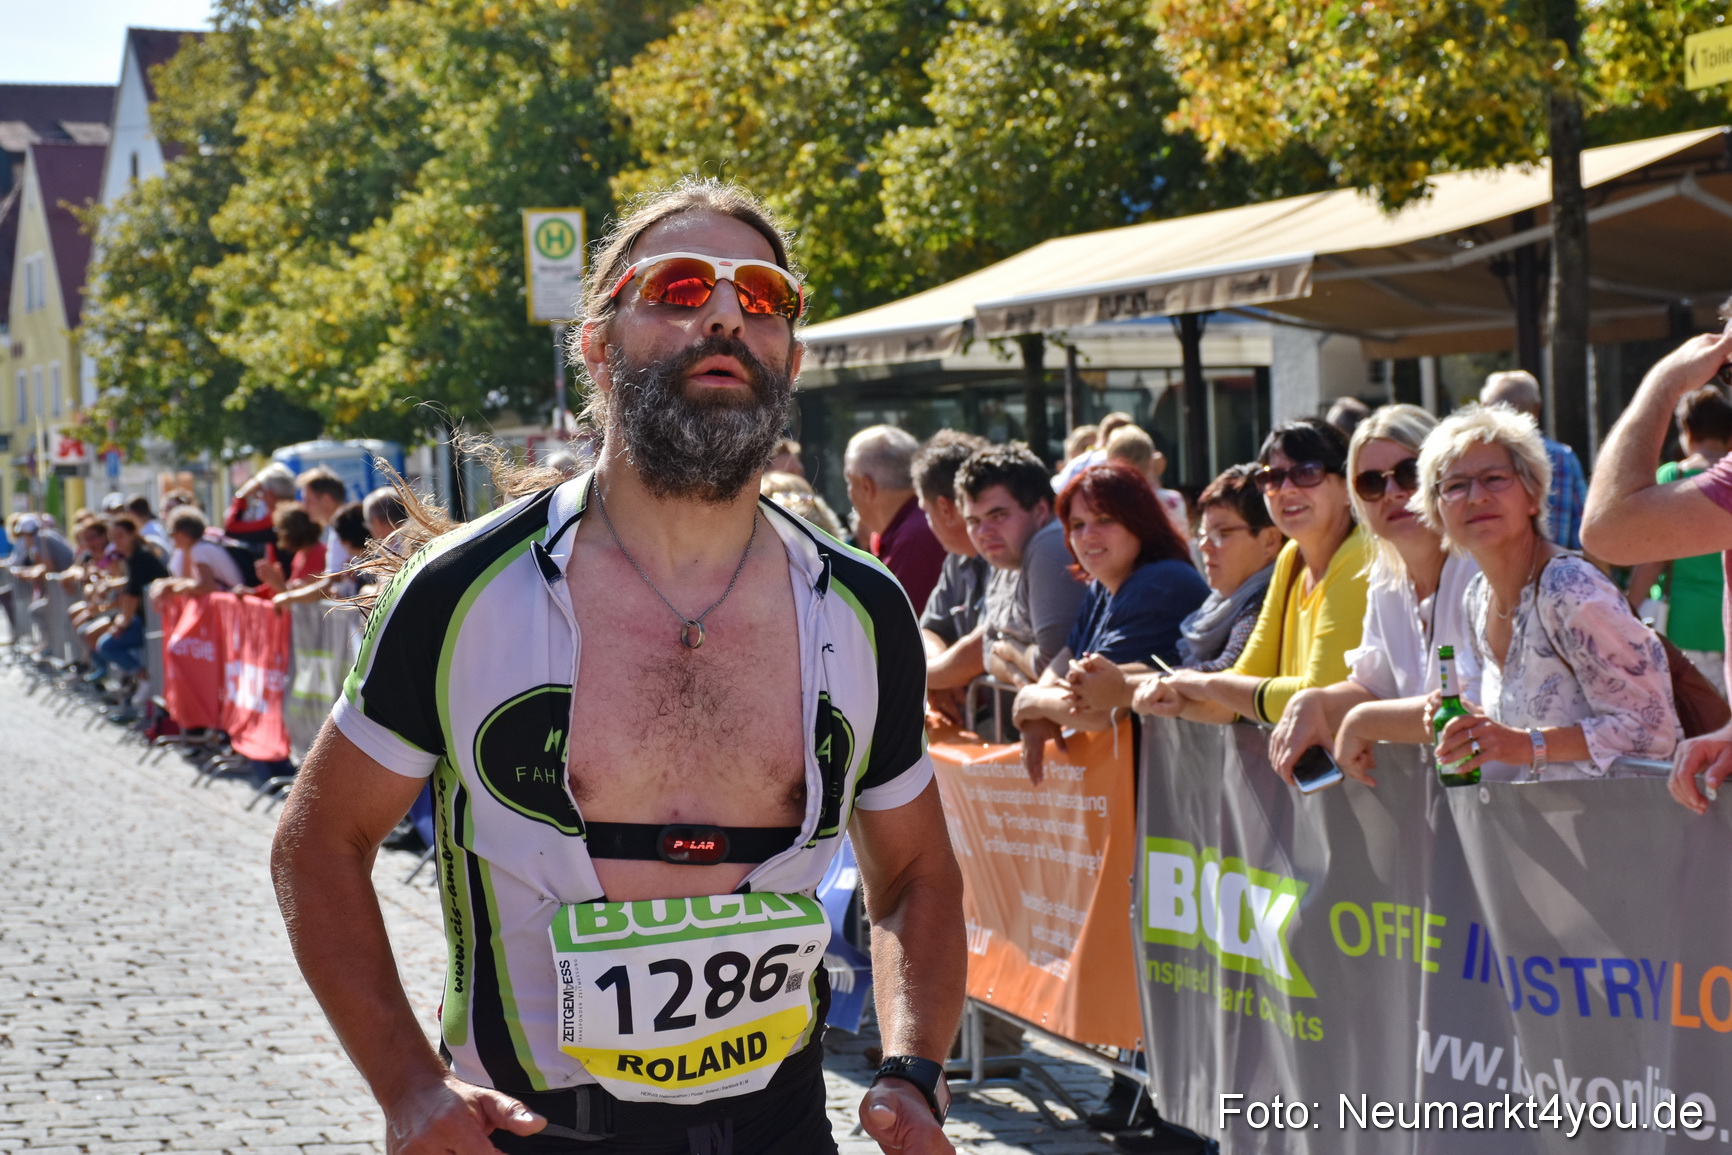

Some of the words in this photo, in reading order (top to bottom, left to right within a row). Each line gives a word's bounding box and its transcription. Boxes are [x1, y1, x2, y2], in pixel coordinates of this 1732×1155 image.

[673, 840, 715, 850] POLAR
[805, 945, 816, 955] B
[594, 943, 800, 1035] 1286
[616, 1031, 768, 1082] ROLAND
